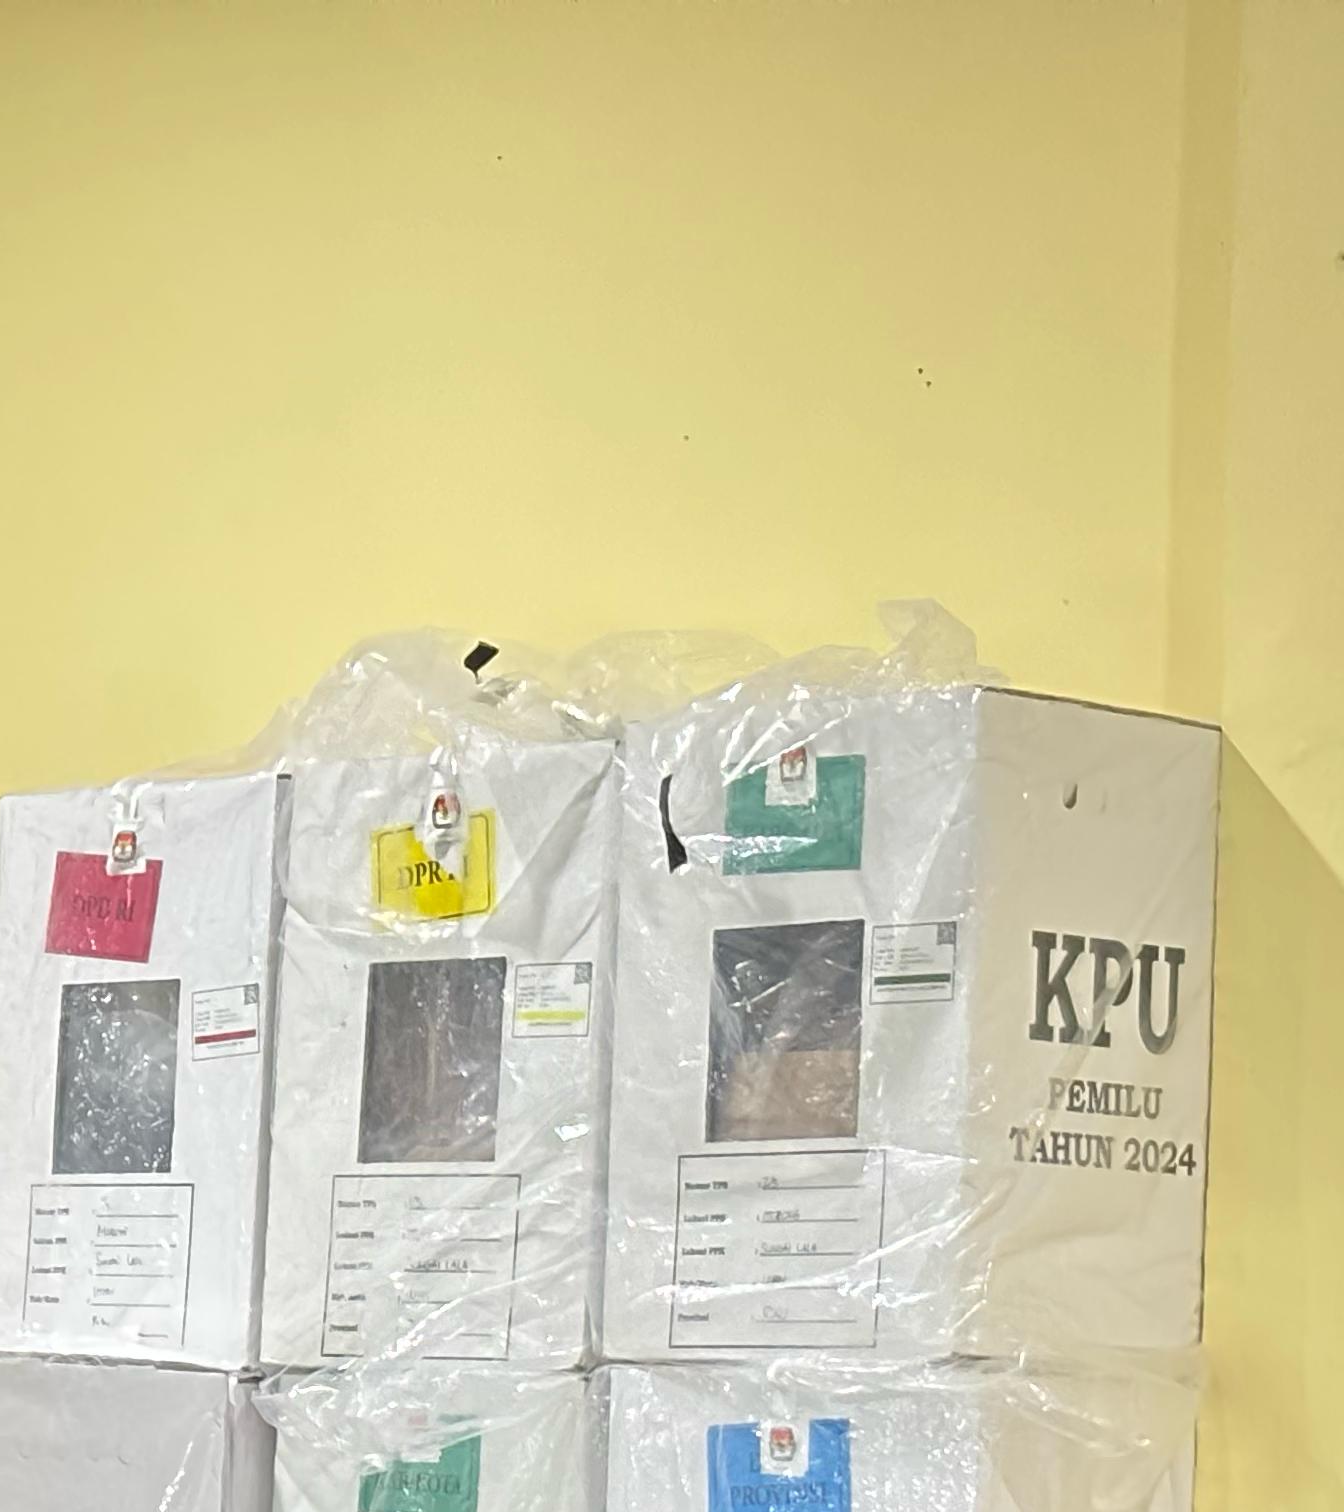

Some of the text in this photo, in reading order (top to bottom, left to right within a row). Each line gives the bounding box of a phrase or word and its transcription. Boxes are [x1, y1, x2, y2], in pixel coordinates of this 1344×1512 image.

[1029, 929, 1186, 1056] KPU
[1048, 1076, 1163, 1120] PEMILU
[1009, 1126, 1197, 1177] TAHUN 2024
